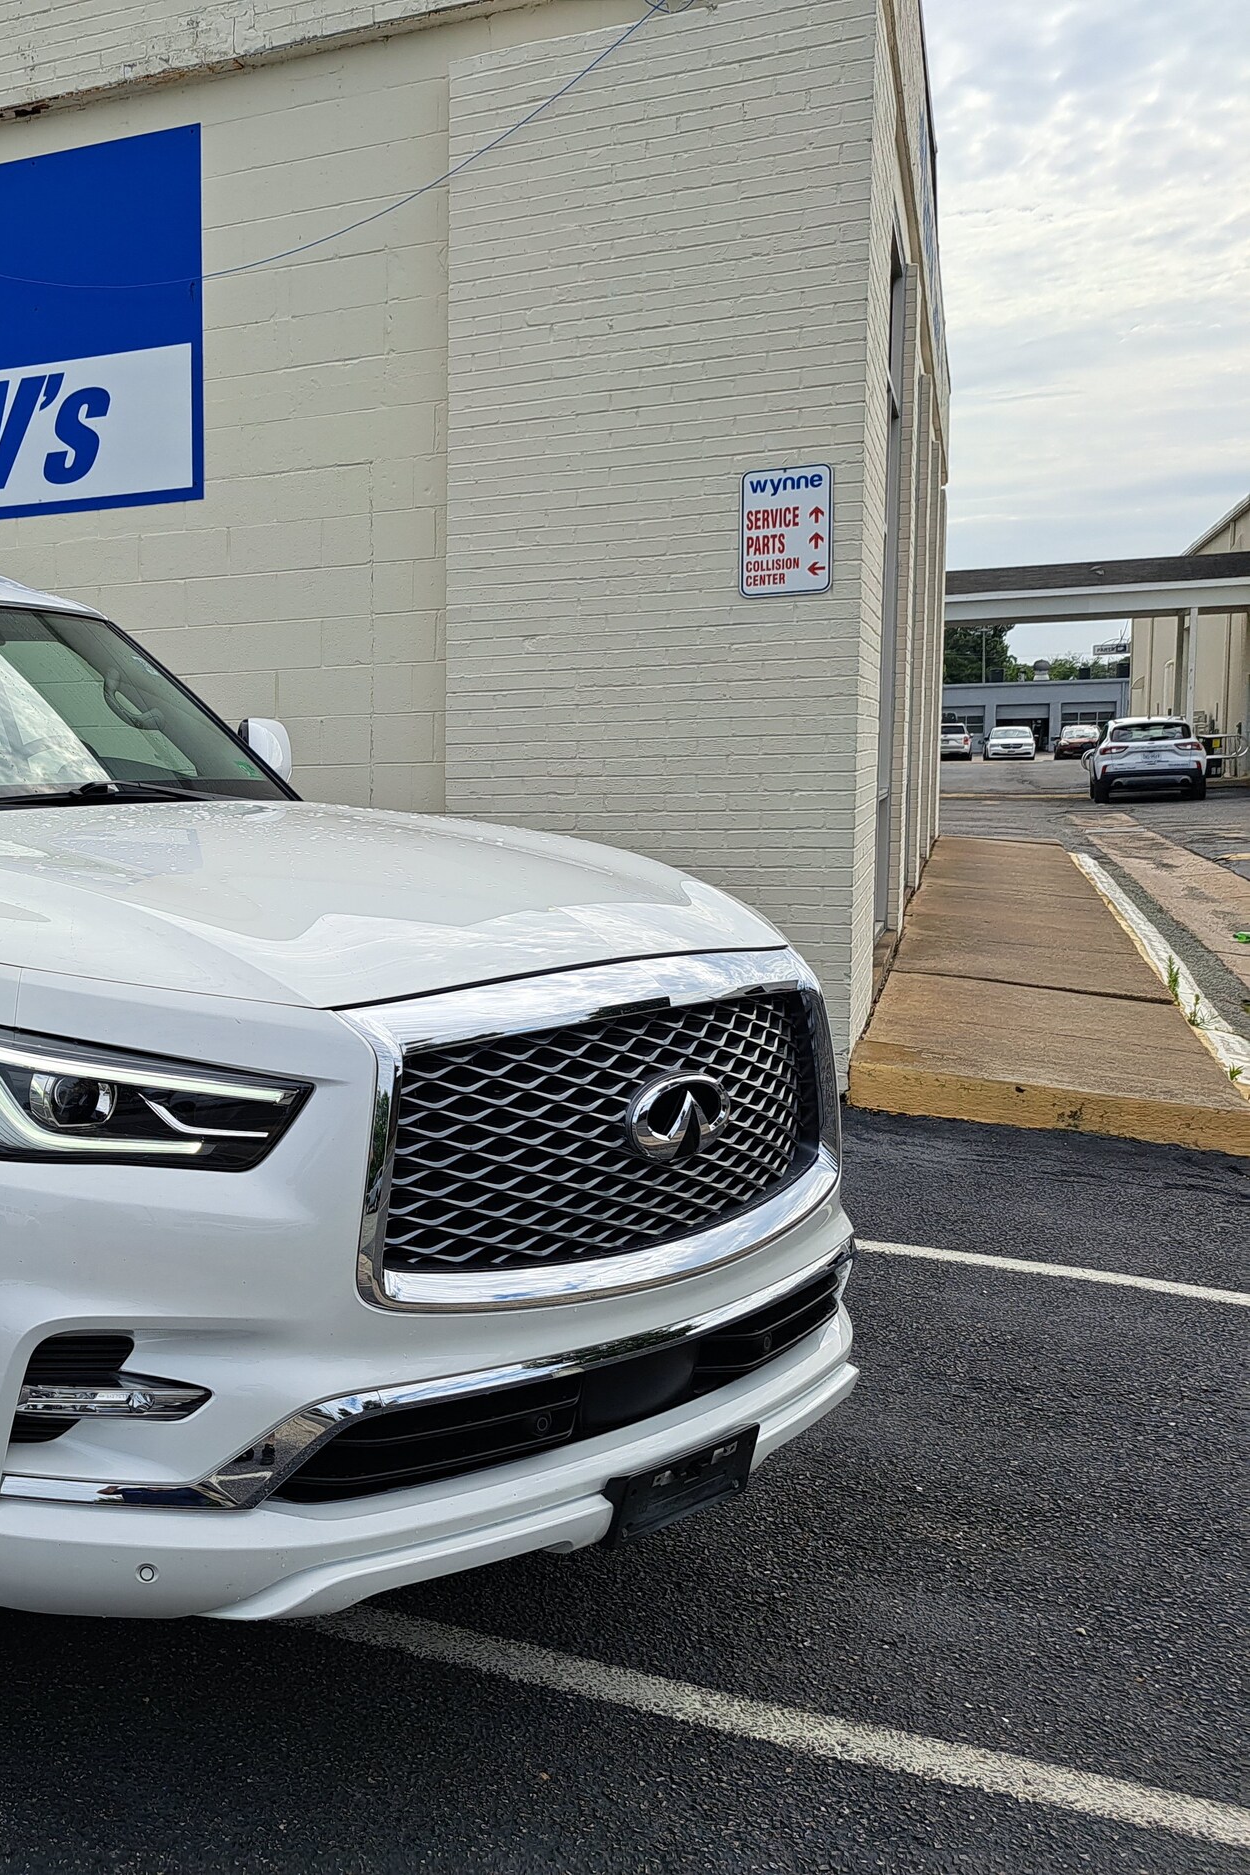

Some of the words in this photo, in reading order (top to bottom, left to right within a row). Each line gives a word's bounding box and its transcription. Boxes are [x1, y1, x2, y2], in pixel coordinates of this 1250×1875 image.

[750, 474, 823, 496] wynne
[746, 506, 800, 531] SERVICE
[746, 533, 785, 556] PARTS
[746, 557, 800, 573] COLLISION
[746, 573, 785, 587] CENTER
